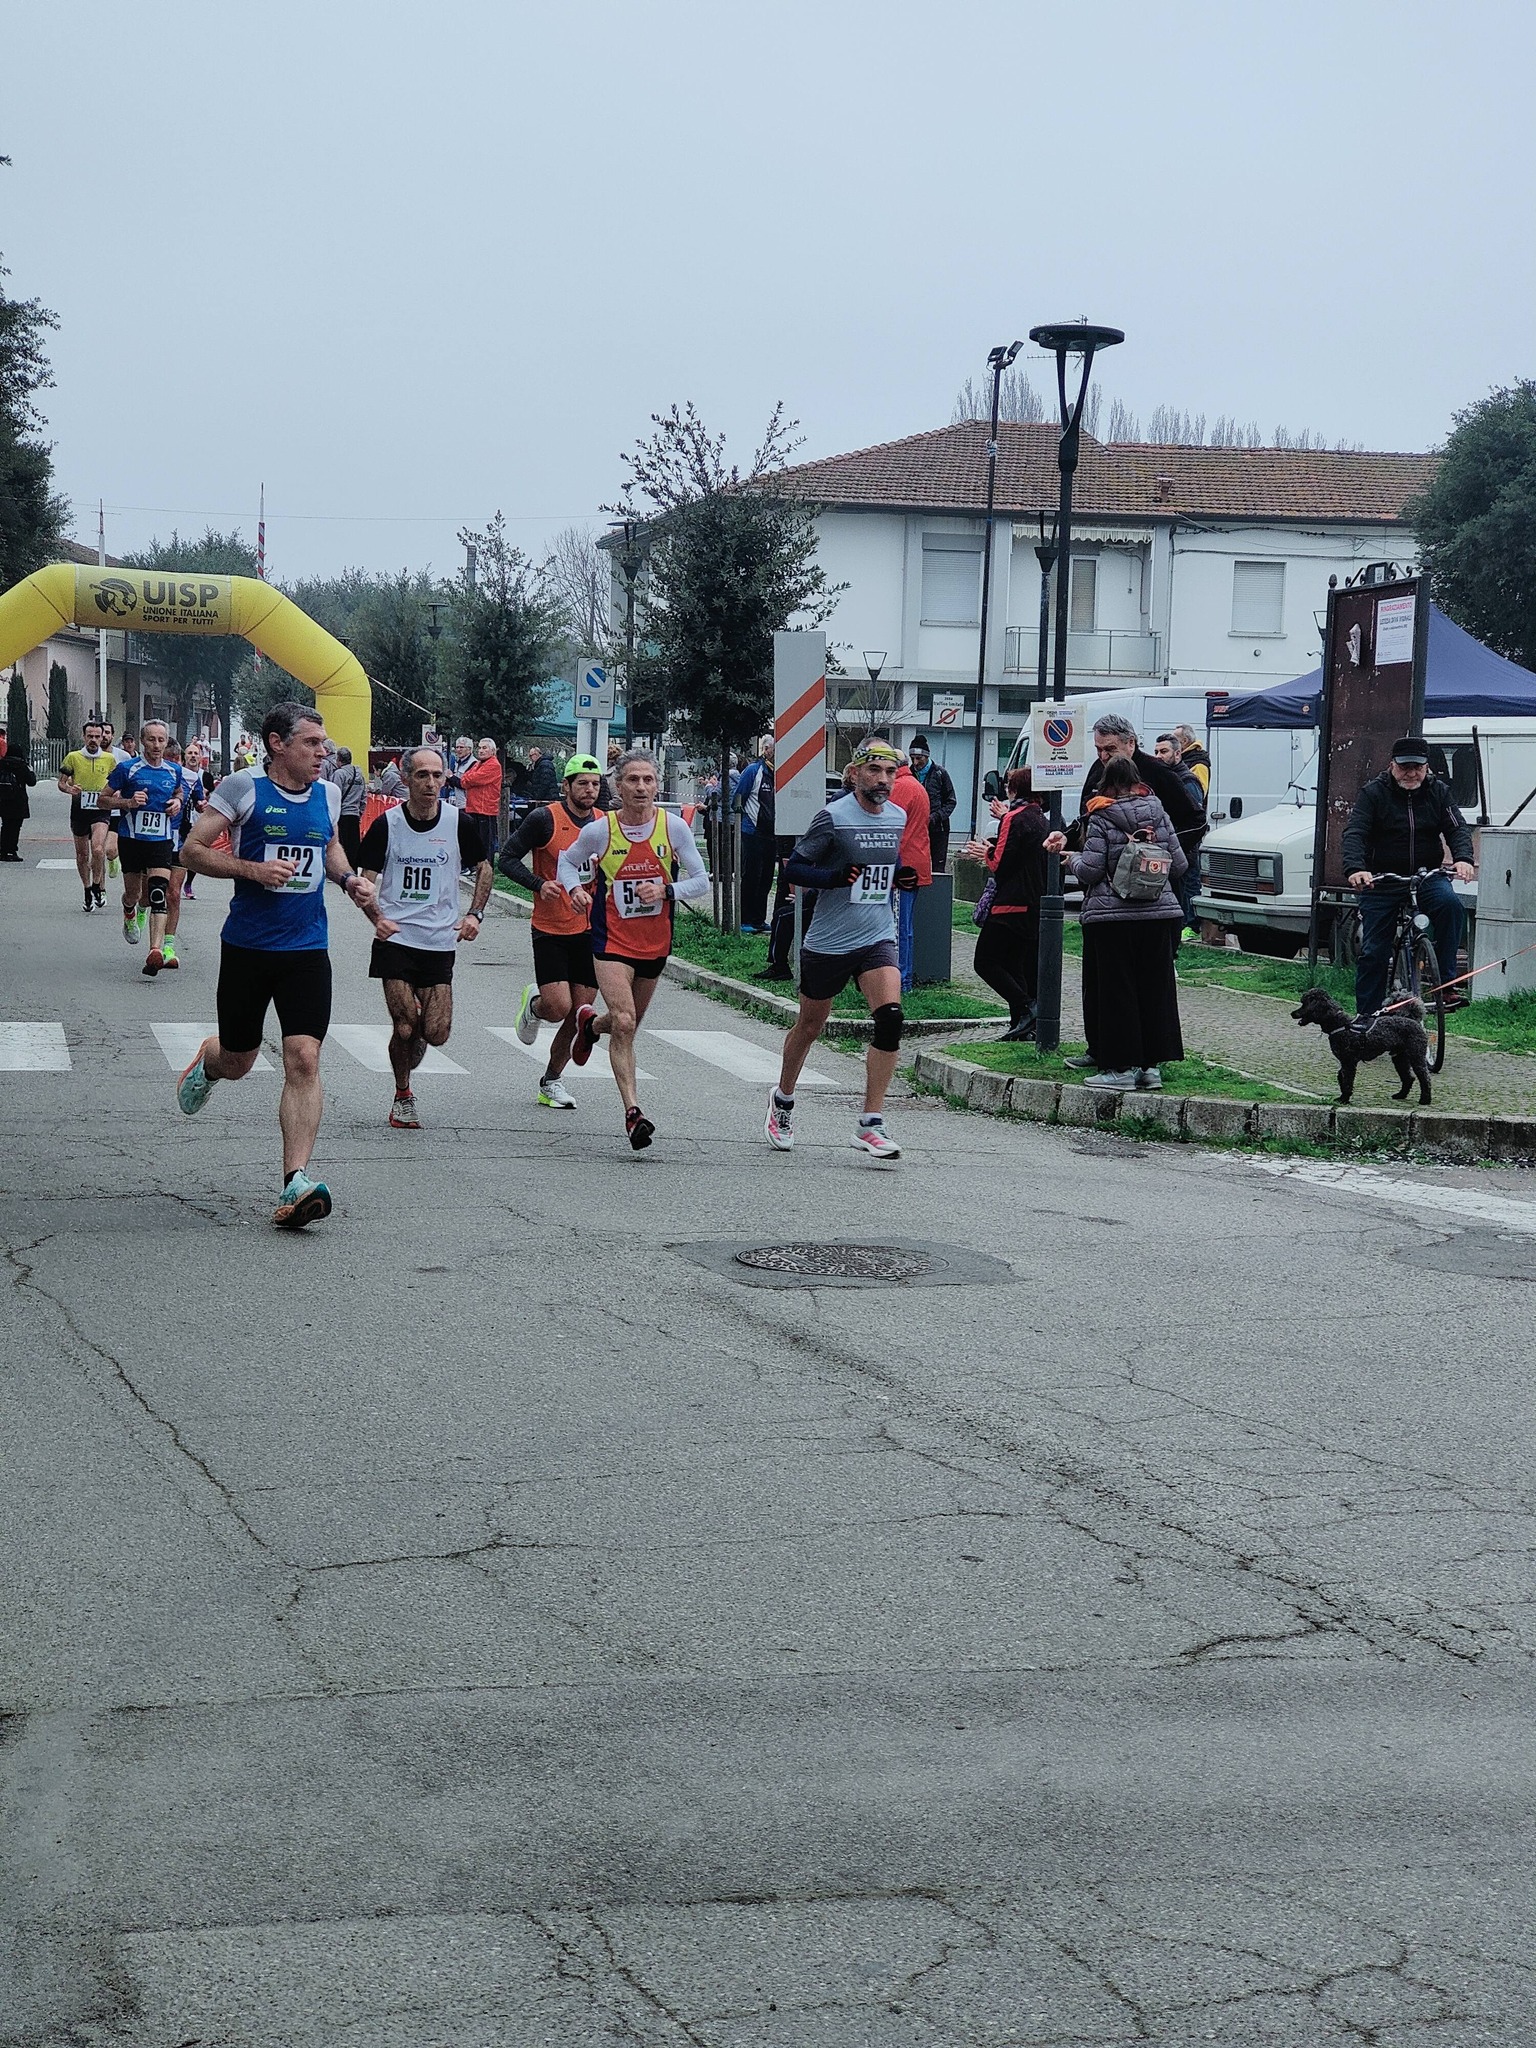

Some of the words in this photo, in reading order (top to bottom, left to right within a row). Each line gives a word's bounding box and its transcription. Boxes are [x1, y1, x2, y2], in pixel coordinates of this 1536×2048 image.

[142, 580, 219, 607] UISP
[142, 605, 177, 616] UNIONE
[180, 608, 219, 618] ITALIANA
[142, 615, 170, 623] SPORT
[191, 618, 214, 626] TUTTI
[142, 812, 161, 828] 673
[854, 832, 898, 840] ATLETICA
[403, 865, 431, 891] 616
[862, 866, 889, 891] 649
